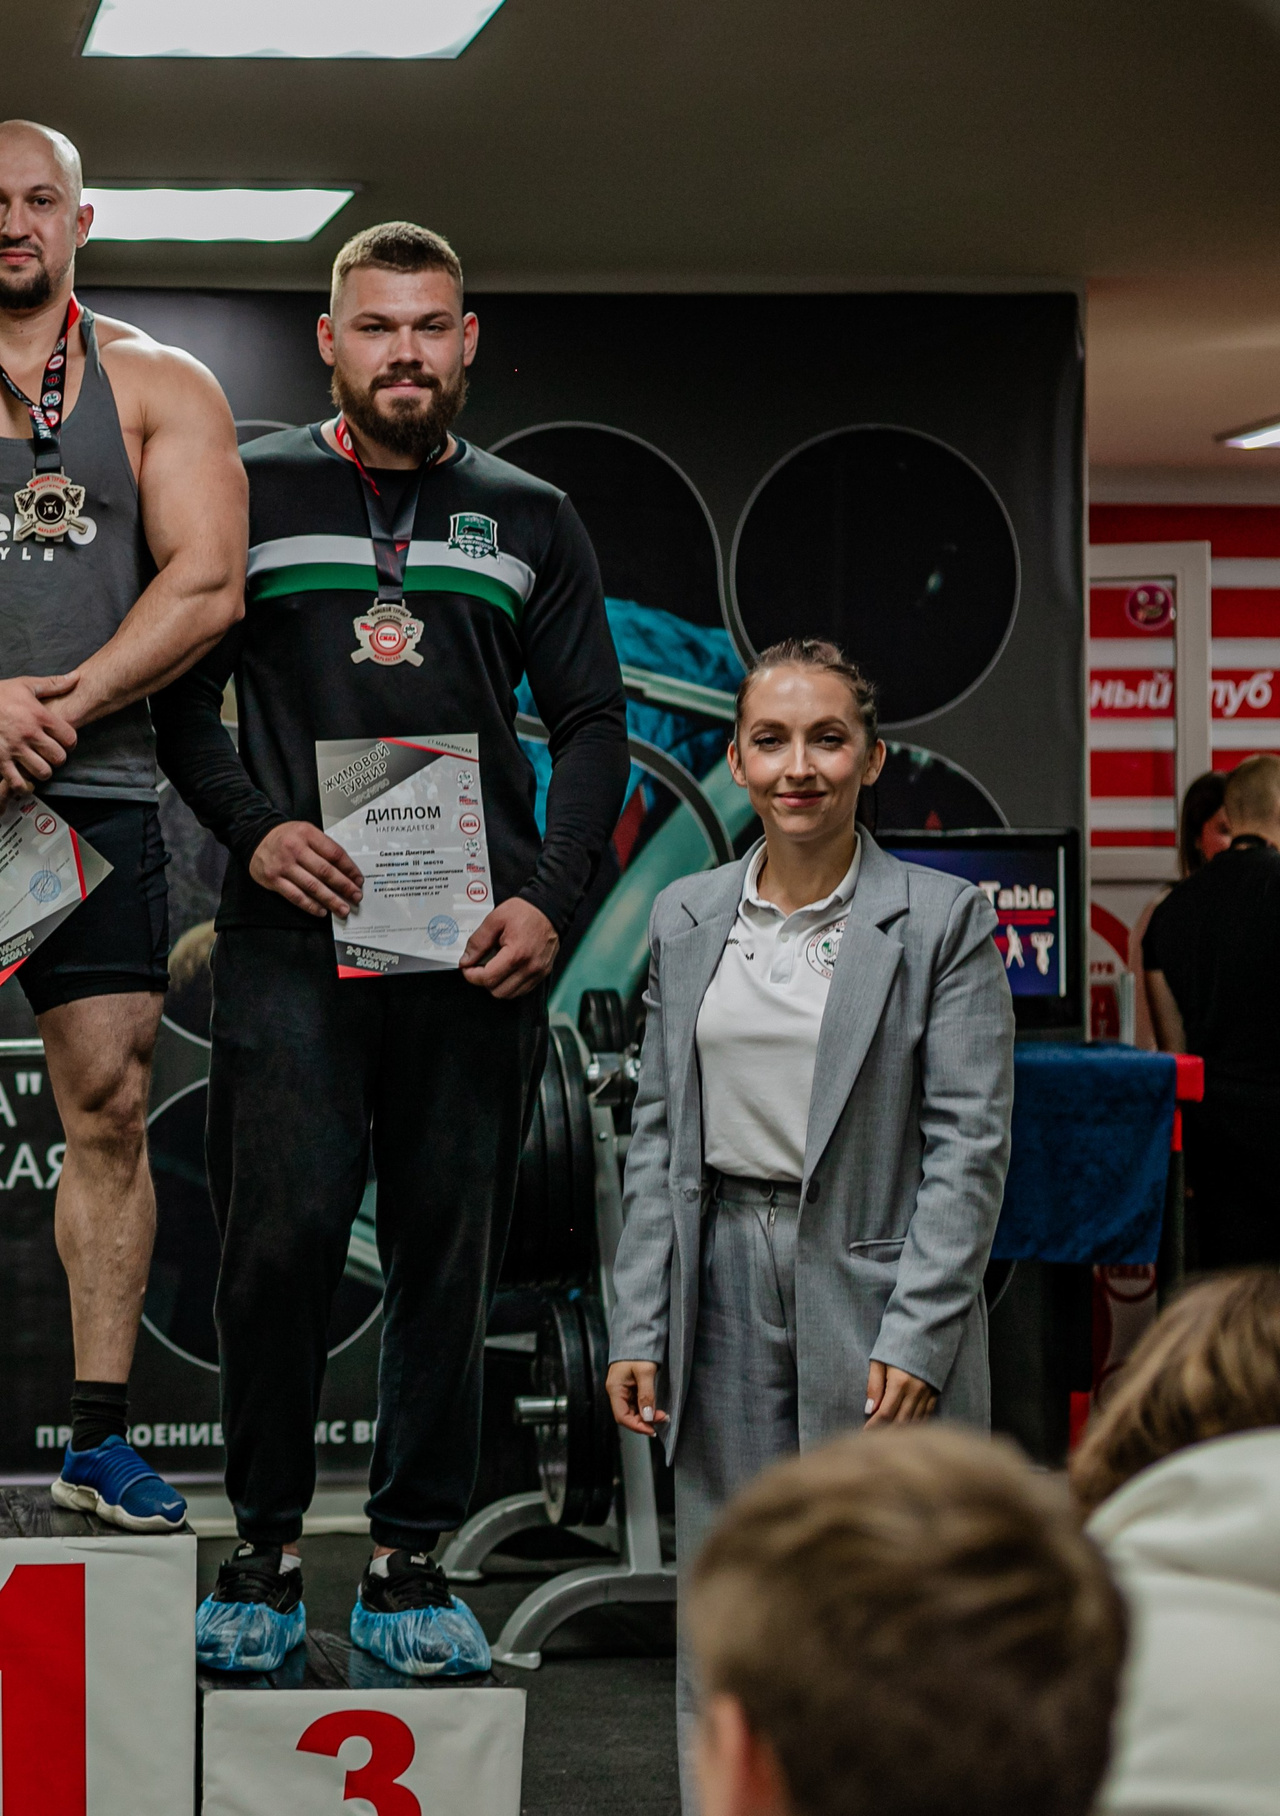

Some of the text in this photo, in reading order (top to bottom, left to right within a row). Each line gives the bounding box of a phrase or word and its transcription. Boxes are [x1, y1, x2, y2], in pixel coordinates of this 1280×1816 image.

[1211, 671, 1274, 718] луб
[321, 741, 391, 794] ЖИМОВОЙ
[339, 760, 387, 798] ТУРНИР
[365, 806, 441, 825] ДИПЛОМ
[376, 824, 435, 833] НАГРАЖДАЕТСЯ
[978, 880, 1055, 911] Table
[294, 1709, 424, 1816] 3
